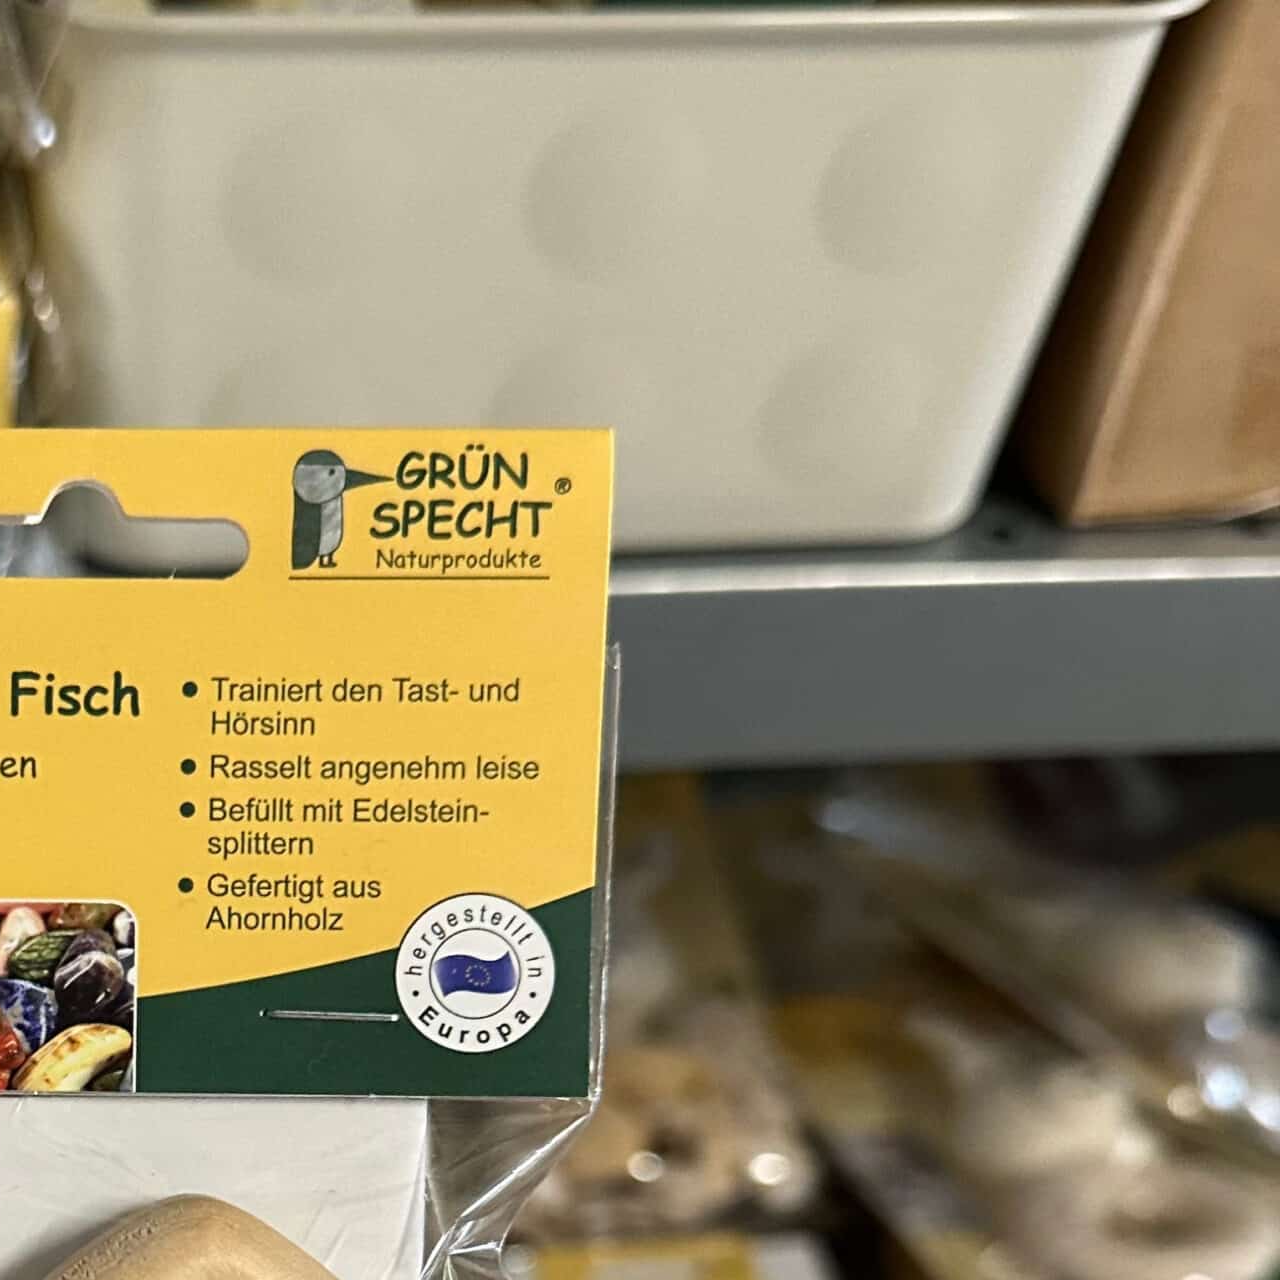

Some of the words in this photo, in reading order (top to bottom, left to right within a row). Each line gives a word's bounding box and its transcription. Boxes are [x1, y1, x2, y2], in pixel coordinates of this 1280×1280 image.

[396, 444, 528, 490] GRÜN
[370, 499, 552, 539] SPECHT
[376, 548, 541, 574] Naturprodukte
[11, 671, 139, 717] Fisch
[211, 677, 322, 702] Trainiert
[332, 678, 382, 702] den
[392, 677, 458, 702] Tast-
[470, 678, 520, 702] und
[212, 711, 315, 735] Hörsinn
[211, 755, 311, 779] Rasselt
[320, 756, 465, 785] angenehm
[477, 755, 539, 779] leise
[209, 797, 293, 822] Befüllt
[303, 798, 342, 822] mit
[353, 798, 489, 822] Edelstein-
[208, 831, 313, 860] splittern
[208, 873, 323, 904] Gefertigt
[333, 880, 381, 898] aus
[206, 906, 343, 931] Ahornholz
[403, 904, 534, 976] hergestellt
[526, 955, 545, 978] in
[418, 1005, 531, 1044] Europa
